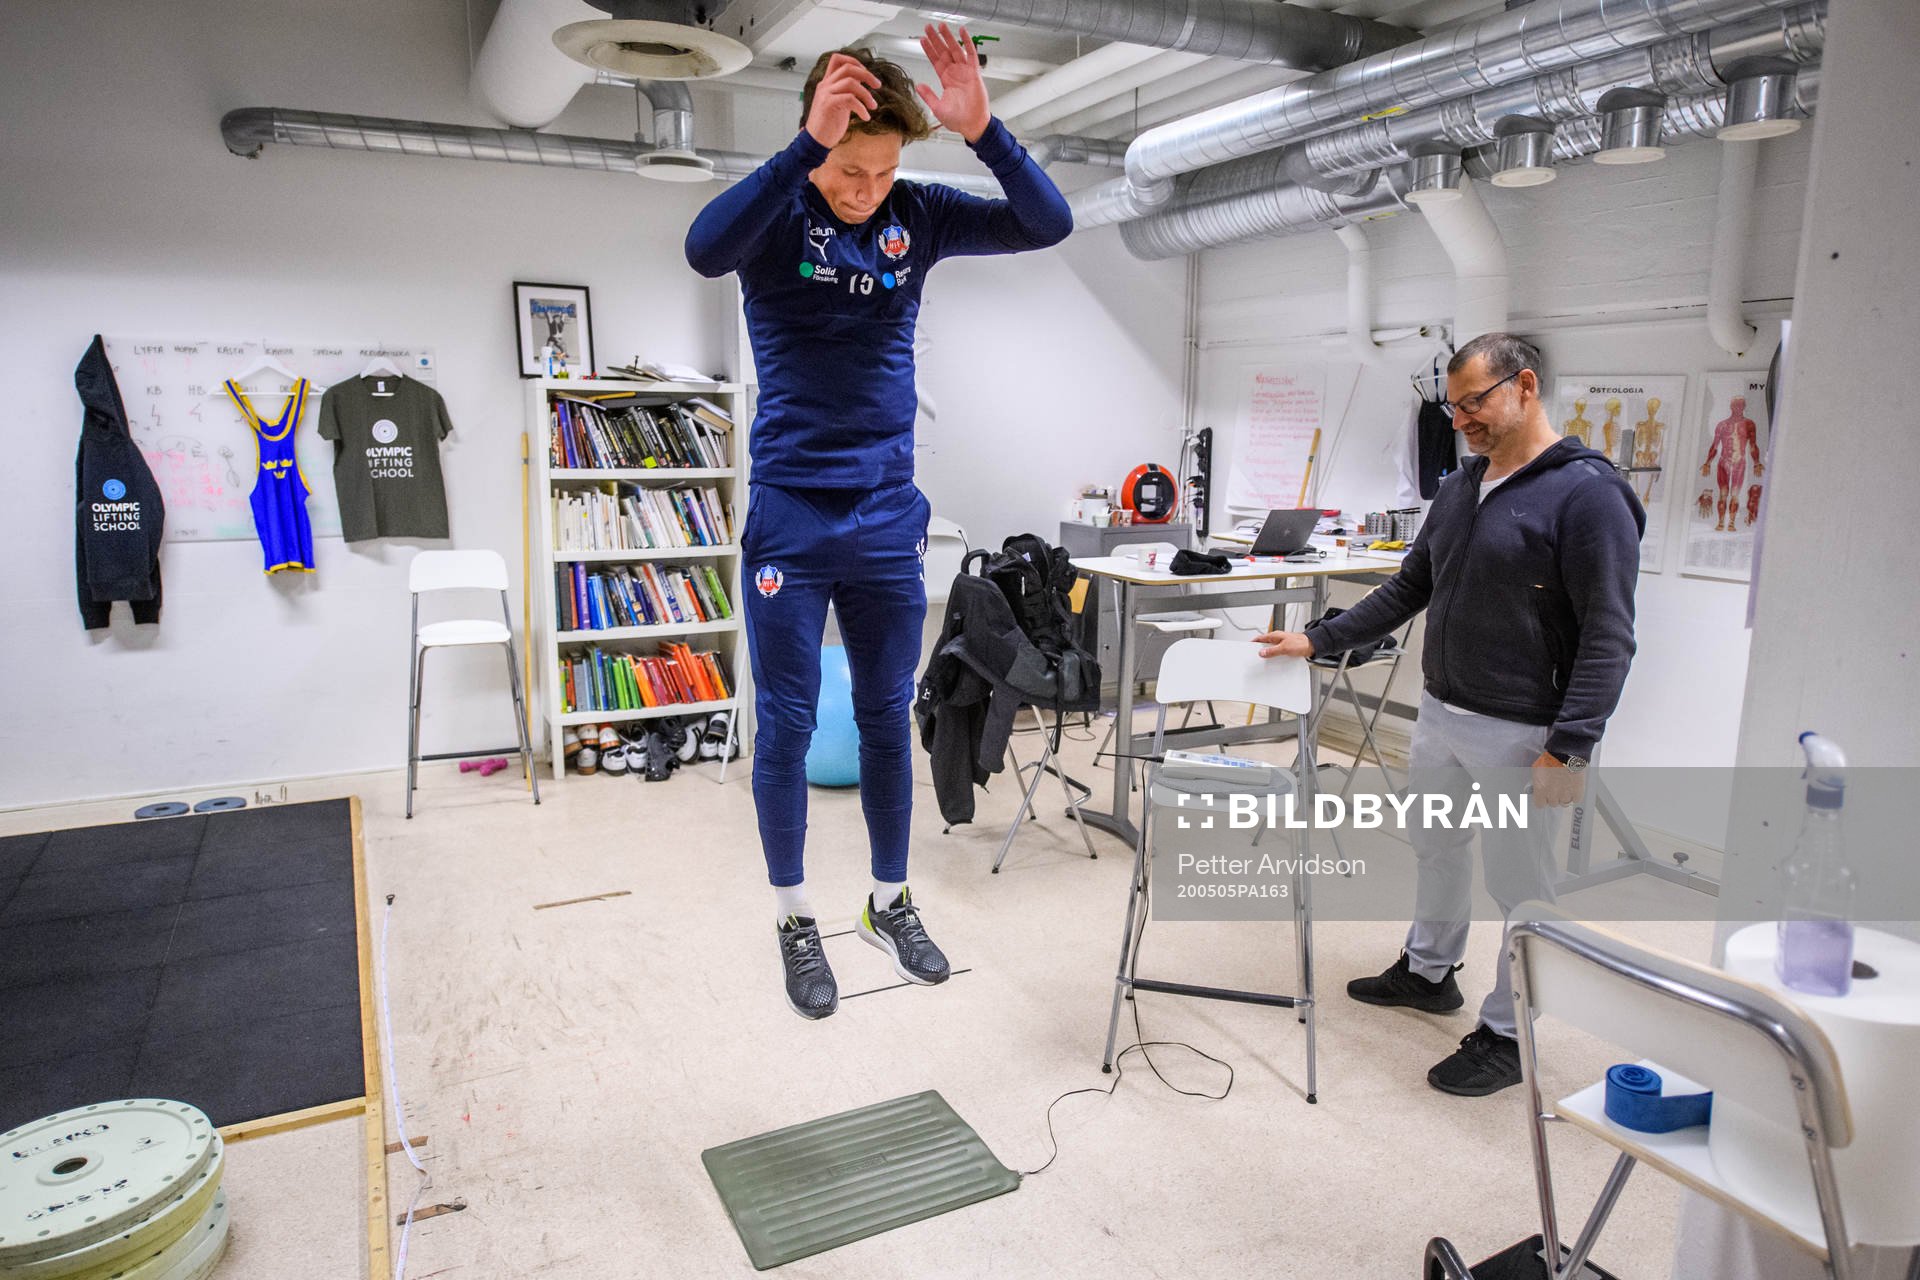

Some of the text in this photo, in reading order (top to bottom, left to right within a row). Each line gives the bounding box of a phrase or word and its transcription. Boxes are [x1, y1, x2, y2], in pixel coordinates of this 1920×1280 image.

[814, 264, 837, 276] Solid
[1589, 386, 1644, 394] OSTEOLOGIA
[370, 468, 414, 478] CHOOL
[91, 501, 140, 512] OLYMPIC
[93, 512, 140, 522] LIFTING
[93, 521, 141, 532] SCHOOL
[1570, 806, 1584, 850] ELEIKO
